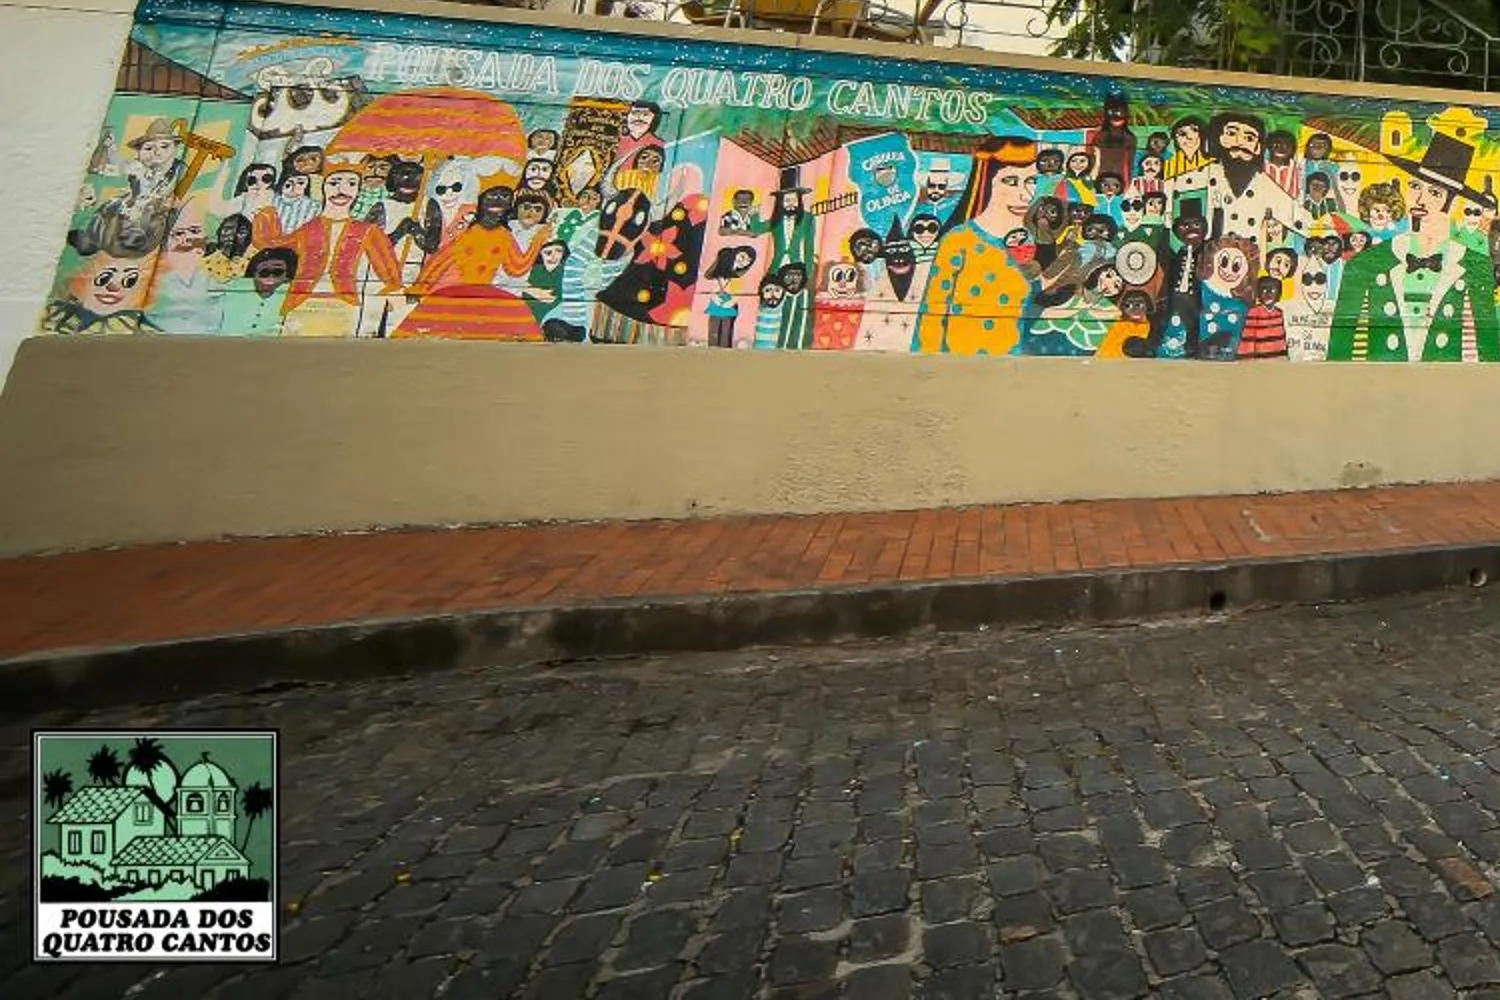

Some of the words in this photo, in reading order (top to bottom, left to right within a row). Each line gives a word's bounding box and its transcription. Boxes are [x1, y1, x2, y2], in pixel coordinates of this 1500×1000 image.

[363, 42, 559, 98] POUSADA
[573, 58, 652, 99] DOS
[661, 66, 813, 111] QUATRO
[827, 79, 994, 124] CANTOS
[866, 191, 912, 213] OLINDA
